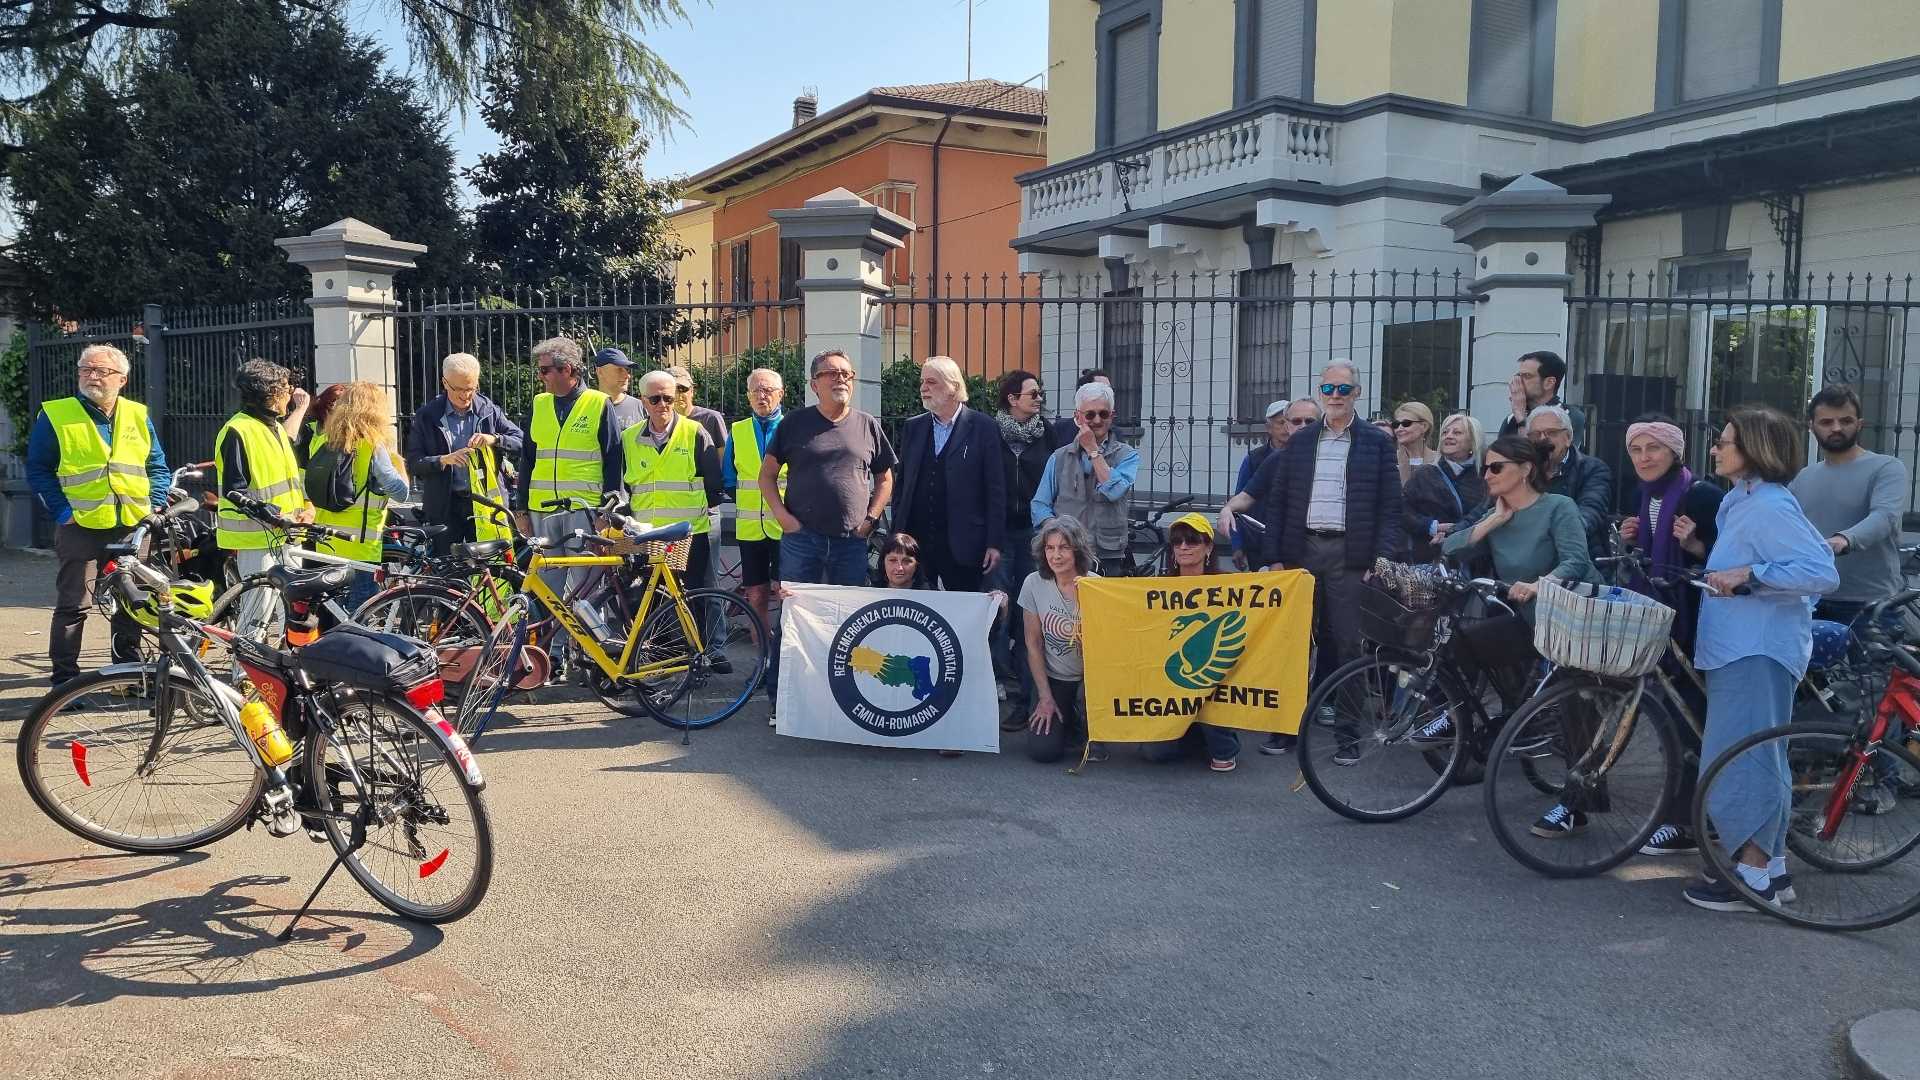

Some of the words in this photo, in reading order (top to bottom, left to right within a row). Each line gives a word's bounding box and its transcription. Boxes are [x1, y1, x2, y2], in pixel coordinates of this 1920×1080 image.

[1146, 584, 1283, 610] PIACENZA
[881, 606, 930, 627] CLIMATICA
[927, 620, 937, 631] E
[837, 609, 881, 653] EMERGENZA
[834, 652, 847, 677] RETE
[932, 626, 957, 683] AMBIENTALE
[1114, 684, 1280, 717] LEGAMENTE
[852, 702, 940, 730] EMILIA-ROMAGNA
